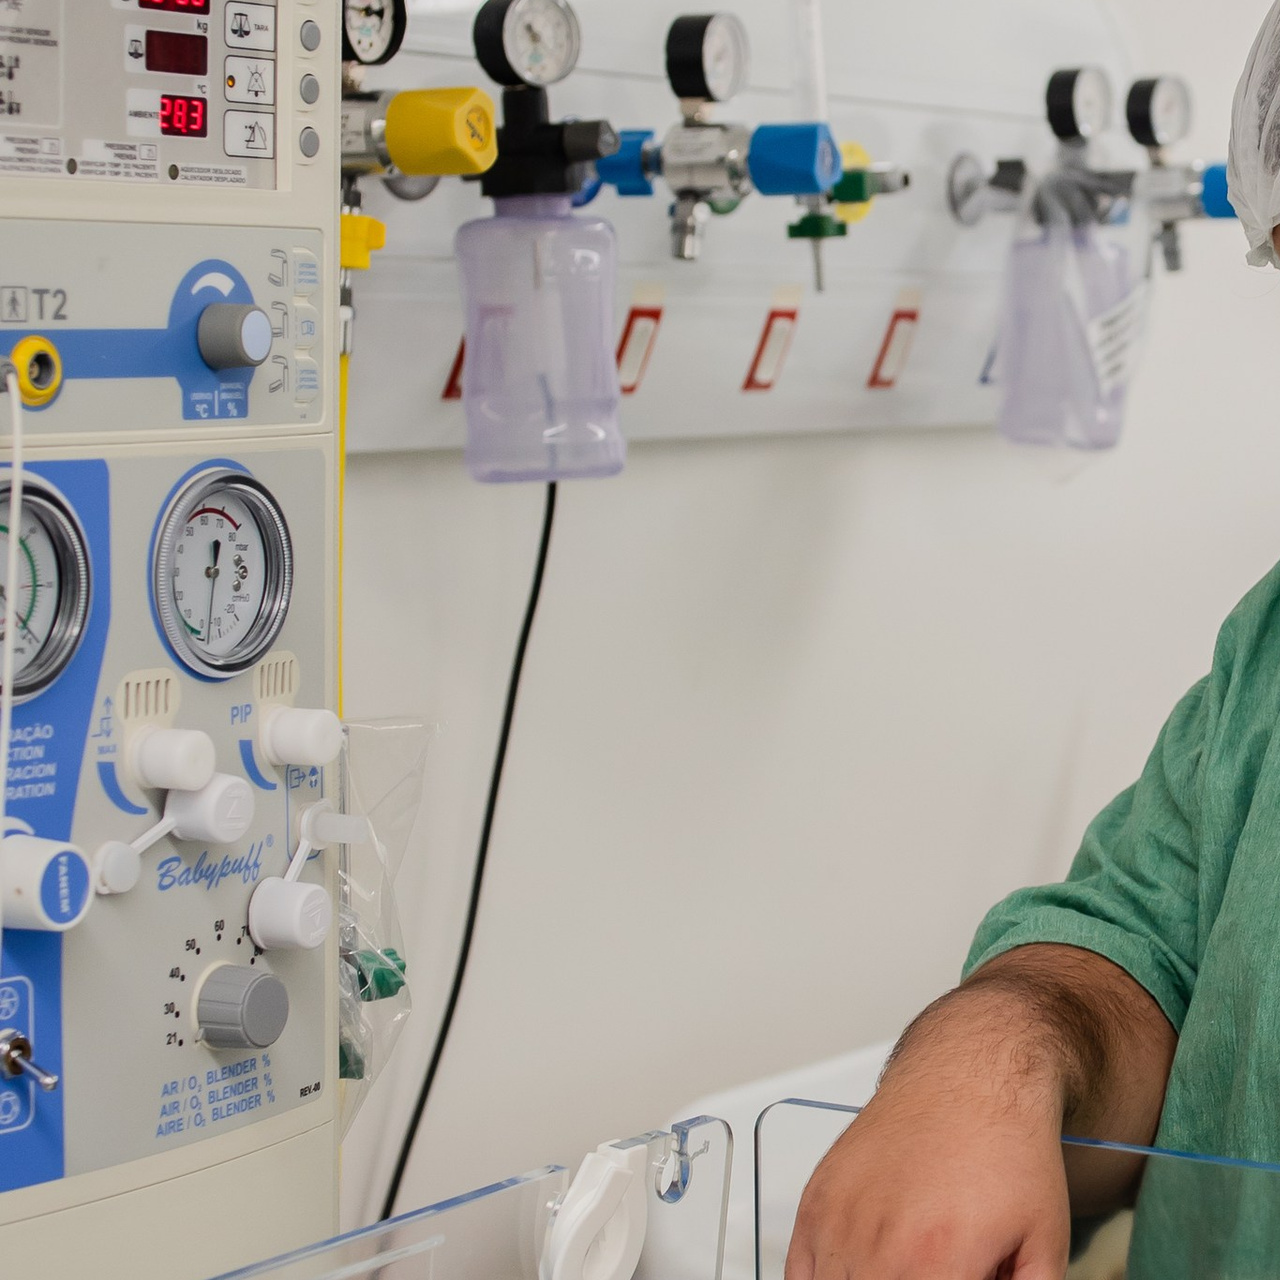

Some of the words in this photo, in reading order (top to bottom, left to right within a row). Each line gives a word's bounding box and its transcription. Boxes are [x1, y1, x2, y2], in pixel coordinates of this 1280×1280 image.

[197, 19, 208, 34] kg
[254, 23, 269, 32] TARA
[32, 288, 67, 320] T2
[216, 518, 224, 529] 70
[235, 543, 249, 552] mbar
[231, 703, 252, 725] PIP
[57, 855, 70, 914] FANEM
[214, 919, 225, 932] 60
[185, 938, 196, 951] 50
[169, 966, 180, 979] 40
[164, 1002, 175, 1015] 30
[166, 1032, 177, 1045] 21
[161, 1080, 178, 1098] AR
[206, 1057, 257, 1086] BLENDER
[262, 1053, 271, 1068] %
[160, 1100, 180, 1119] AIR
[208, 1076, 258, 1105] BLENDER
[263, 1072, 272, 1086] %
[156, 1117, 184, 1138] AIRE
[212, 1093, 262, 1122] BLENDER
[266, 1089, 276, 1104] %
